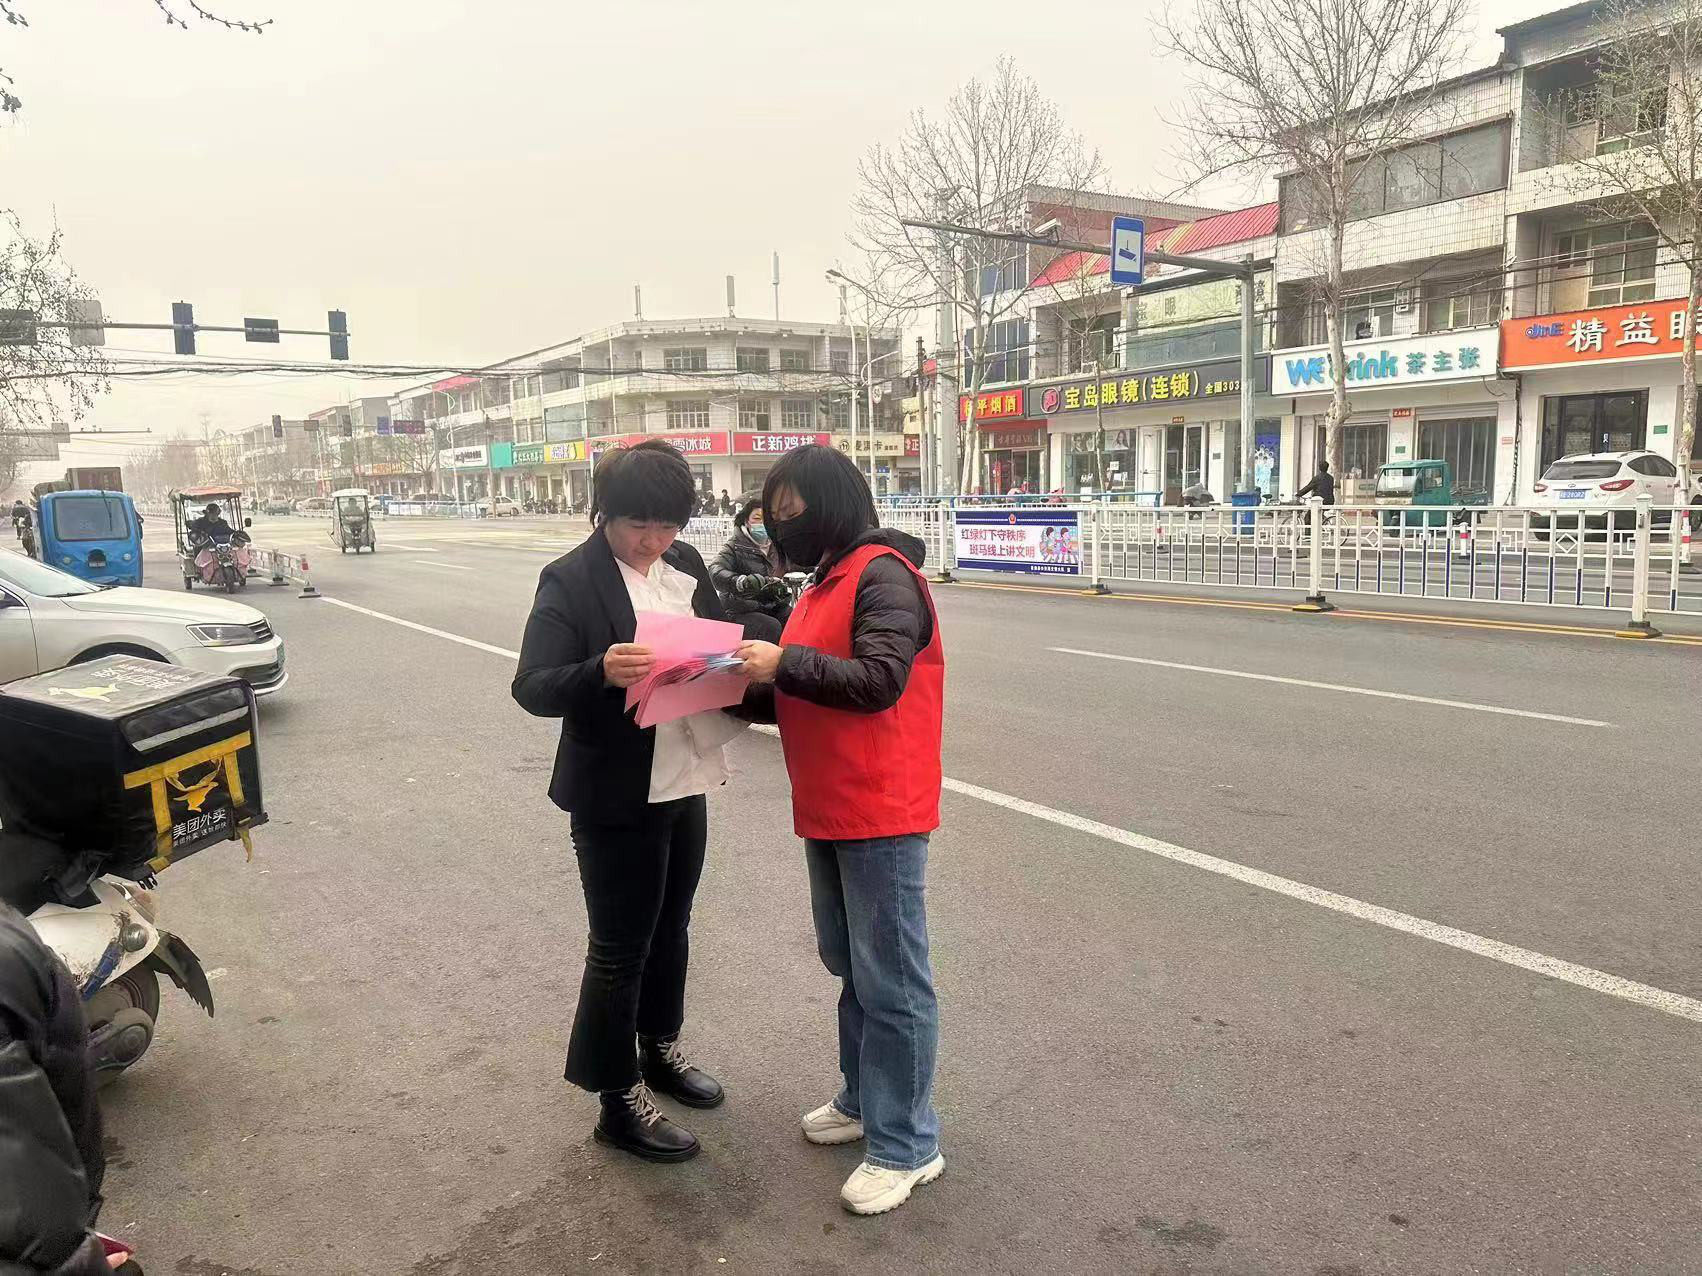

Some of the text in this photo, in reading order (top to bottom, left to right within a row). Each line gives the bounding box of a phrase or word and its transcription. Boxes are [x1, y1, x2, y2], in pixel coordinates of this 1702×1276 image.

[1406, 347, 1480, 375] 茶主张
[960, 528, 1027, 542] 红绿灯下守秩序
[969, 544, 1036, 558] 斑马线上讲文明
[172, 807, 227, 840] 美团外卖
